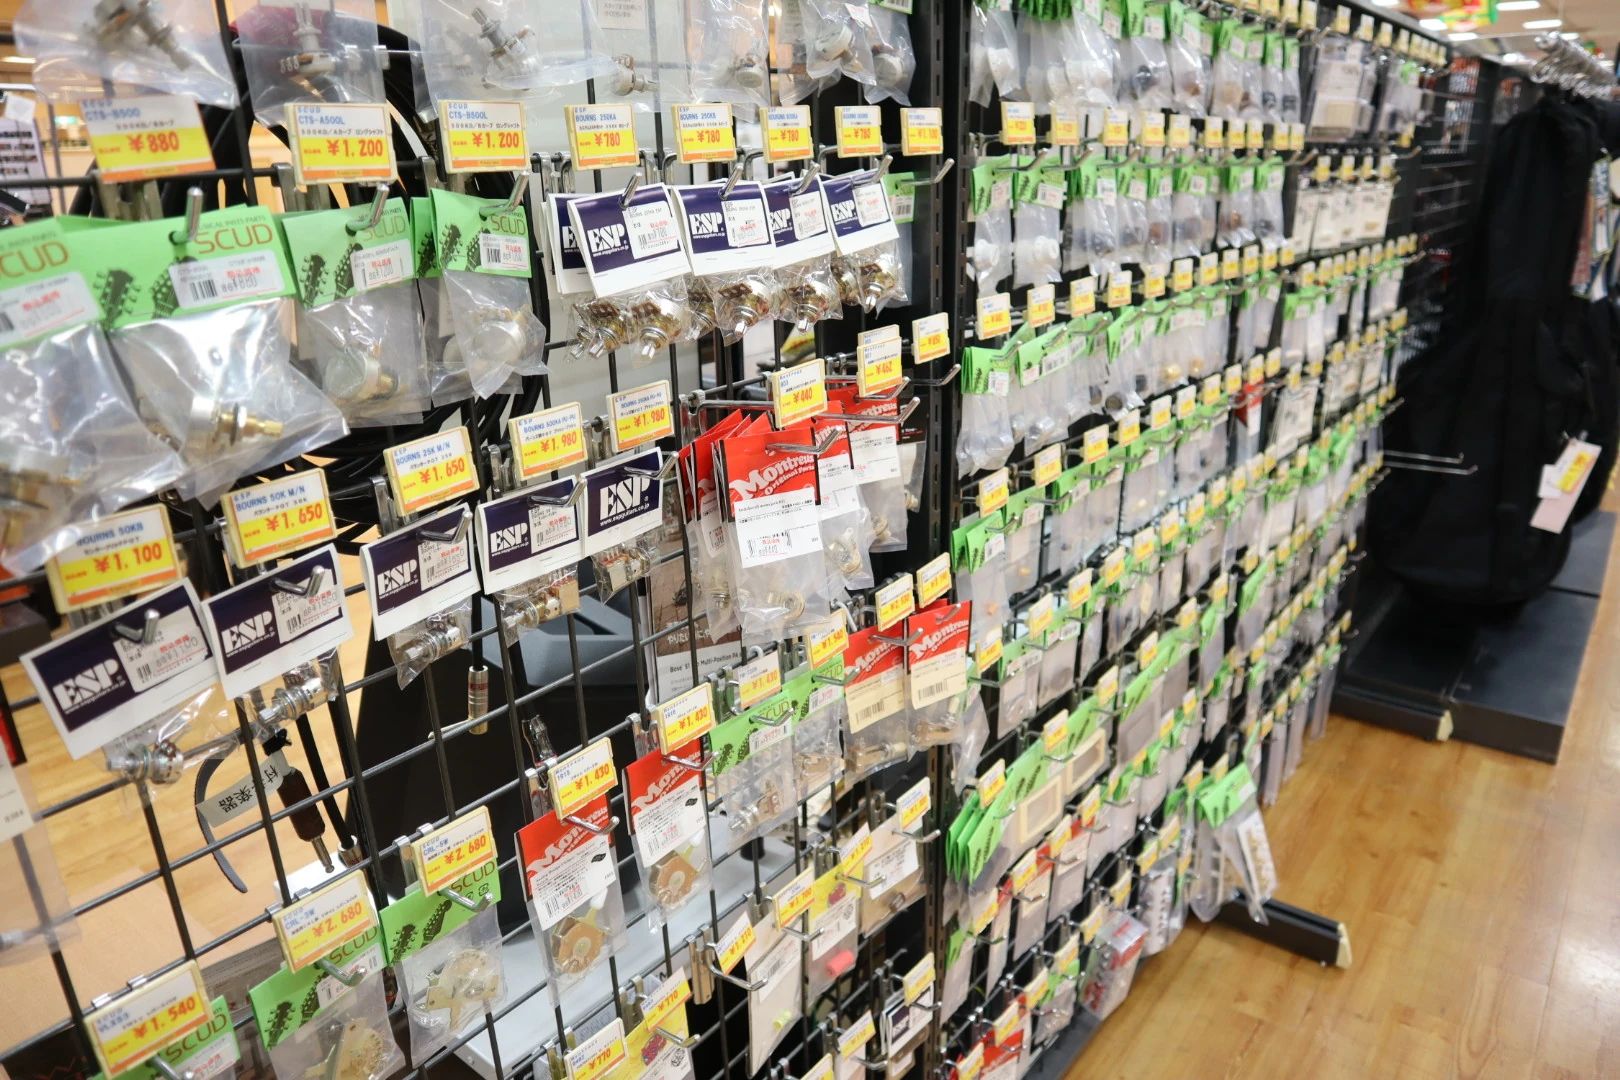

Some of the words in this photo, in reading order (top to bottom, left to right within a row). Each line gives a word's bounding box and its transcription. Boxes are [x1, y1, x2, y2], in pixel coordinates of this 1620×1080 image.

[126, 131, 180, 153] ¥880
[594, 132, 621, 148] ¥780
[696, 130, 721, 144] ¥780
[689, 212, 723, 235] ESP
[830, 200, 856, 222] ESP
[364, 215, 406, 241] SCUD
[490, 214, 526, 235] SCUD
[194, 224, 273, 254] SCUD
[587, 223, 626, 253] ESP
[793, 387, 812, 405] ¥440
[396, 452, 421, 466] BOURNS
[729, 453, 816, 500] Montreux
[765, 470, 800, 495] Original
[236, 496, 268, 512] BOURNS
[287, 485, 305, 497] M/N
[600, 476, 650, 520] ESP
[600, 503, 650, 527] www.espguitars.co.jp
[490, 522, 528, 553] ESP
[377, 559, 418, 596] ESP
[221, 611, 273, 653] ESP
[670, 663, 682, 673] Bose
[700, 654, 731, 666] Multi-Position
[53, 659, 119, 710] ESP
[219, 765, 279, 813] 村楽器
[451, 861, 496, 893] SCUD
[330, 926, 378, 964] SCUD
[658, 990, 679, 1013] ¥770
[166, 1014, 227, 1063] SCUD
[588, 1048, 611, 1070] ¥770
